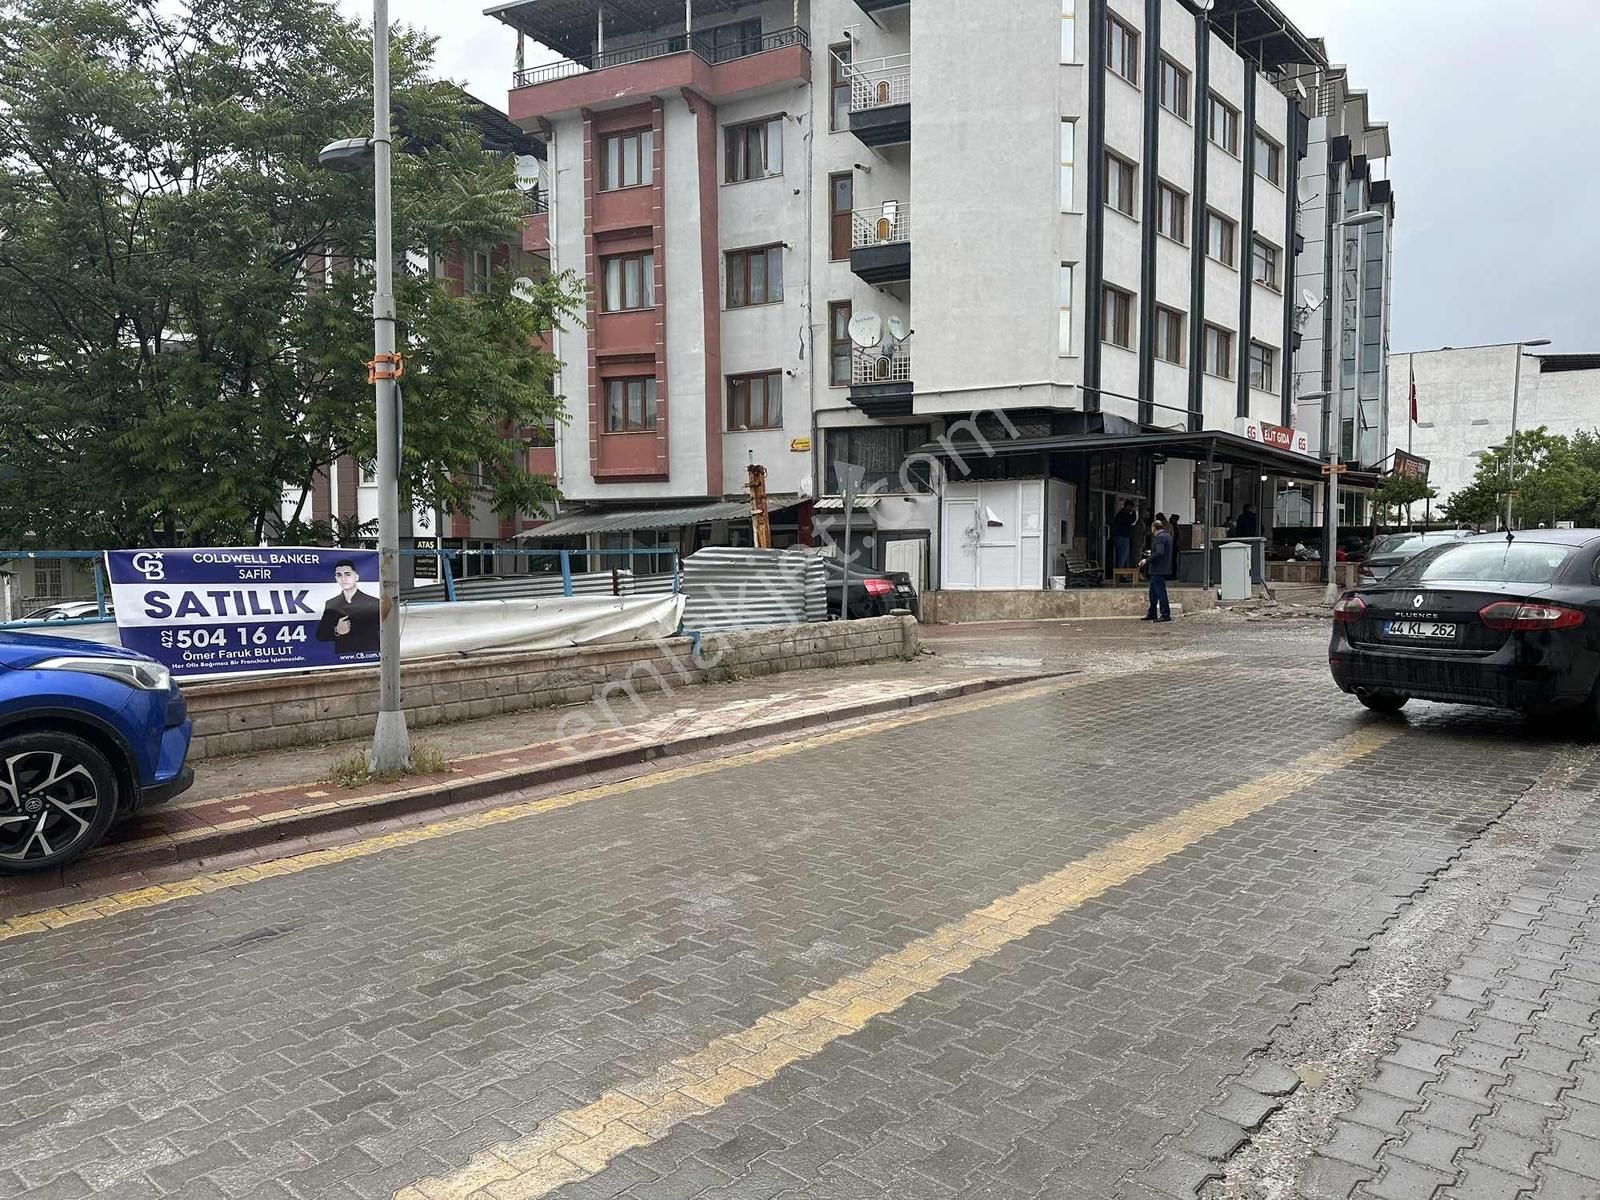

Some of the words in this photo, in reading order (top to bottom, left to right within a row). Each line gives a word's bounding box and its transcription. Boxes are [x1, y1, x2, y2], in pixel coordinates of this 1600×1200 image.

[1276, 432, 1290, 445] GIDA
[417, 540, 435, 549] ATAŞ
[192, 553, 267, 564] COLDWELL
[270, 553, 320, 564] BANKER
[238, 567, 272, 580] SAFİR
[144, 589, 316, 619] SATILIK
[176, 628, 227, 649] 504
[237, 626, 267, 645] 16
[275, 625, 307, 643] 44
[1390, 622, 1404, 634] 44
[1408, 623, 1426, 635] KL
[1431, 624, 1456, 637] 262
[161, 630, 173, 648] 422
[182, 650, 216, 661] Ömer
[218, 648, 252, 659] Faruk
[254, 646, 294, 656] BULUT
